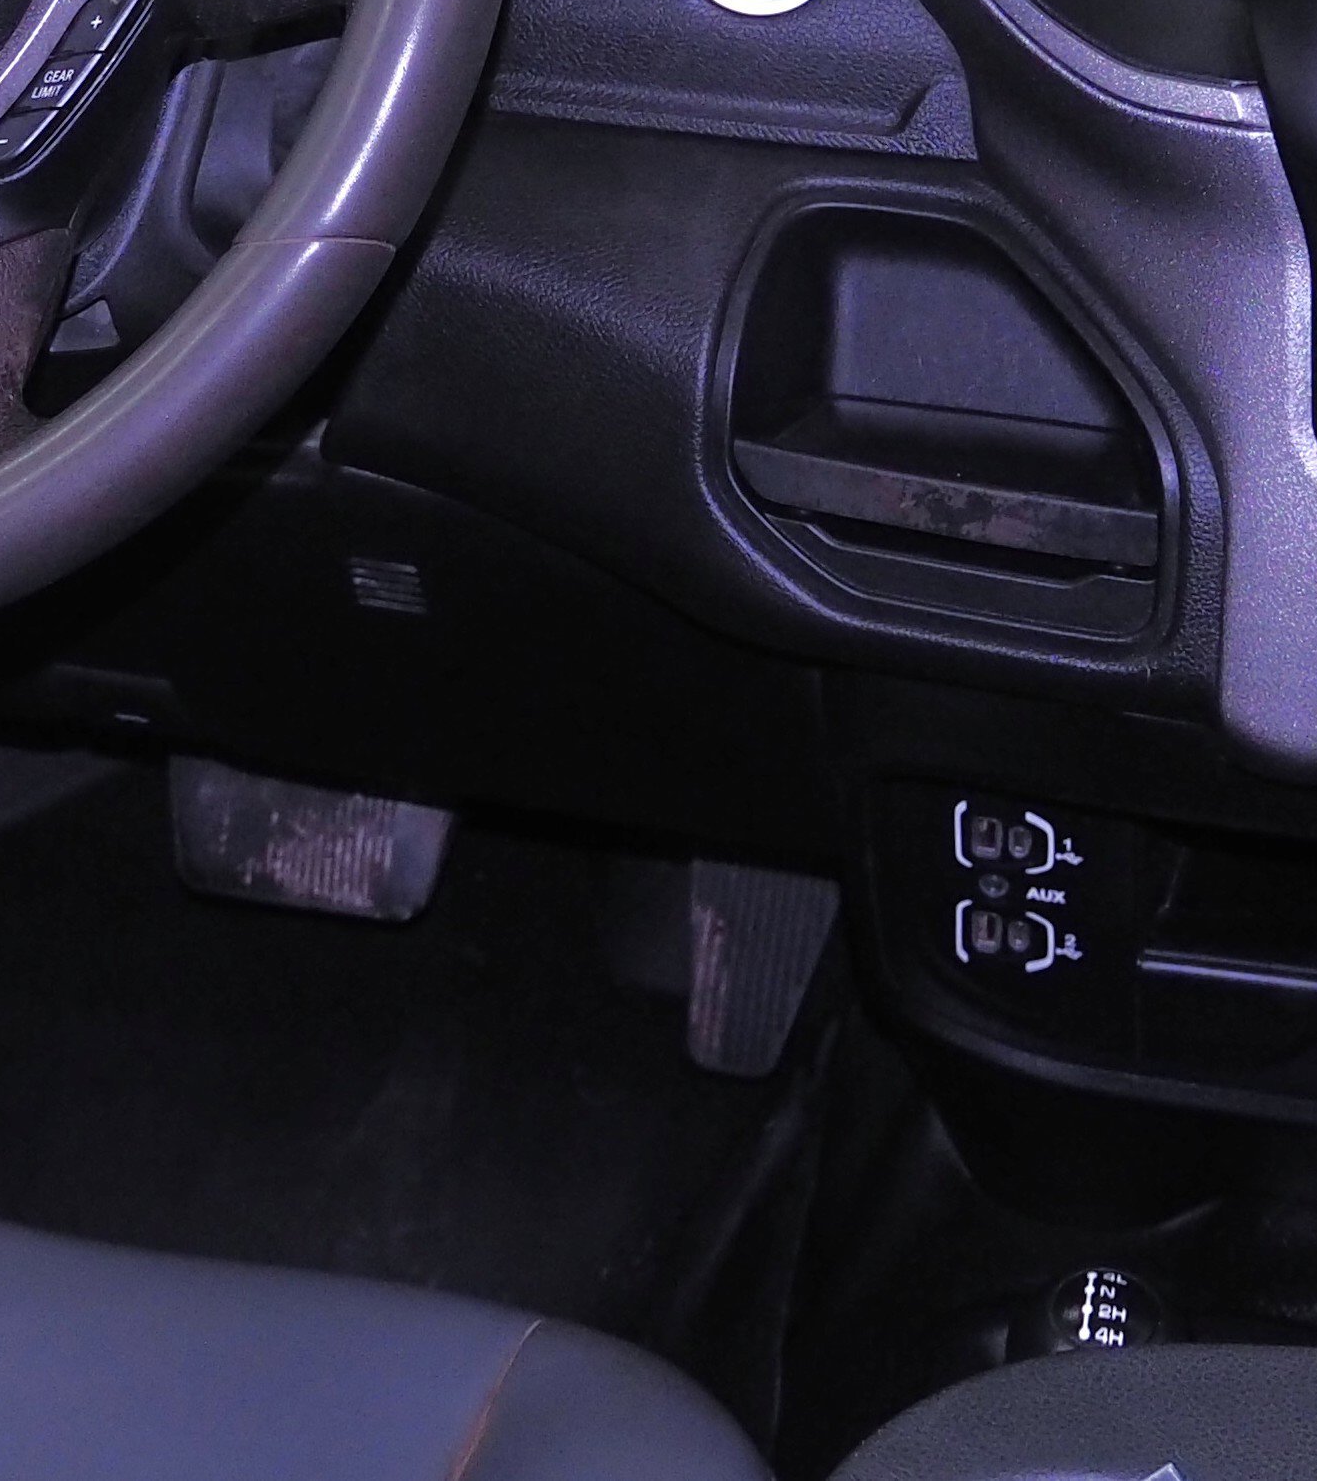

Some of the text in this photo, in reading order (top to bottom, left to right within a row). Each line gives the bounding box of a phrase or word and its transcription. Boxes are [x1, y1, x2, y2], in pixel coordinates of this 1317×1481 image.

[44, 69, 74, 84] GEAR
[31, 84, 63, 99] LIMIT
[1062, 837, 1072, 852] 1
[1025, 886, 1067, 905] AUX
[1064, 933, 1077, 950] 2
[1099, 1285, 1116, 1299] N
[1098, 1303, 1127, 1323] 2H
[1095, 1327, 1124, 1347] 4H
